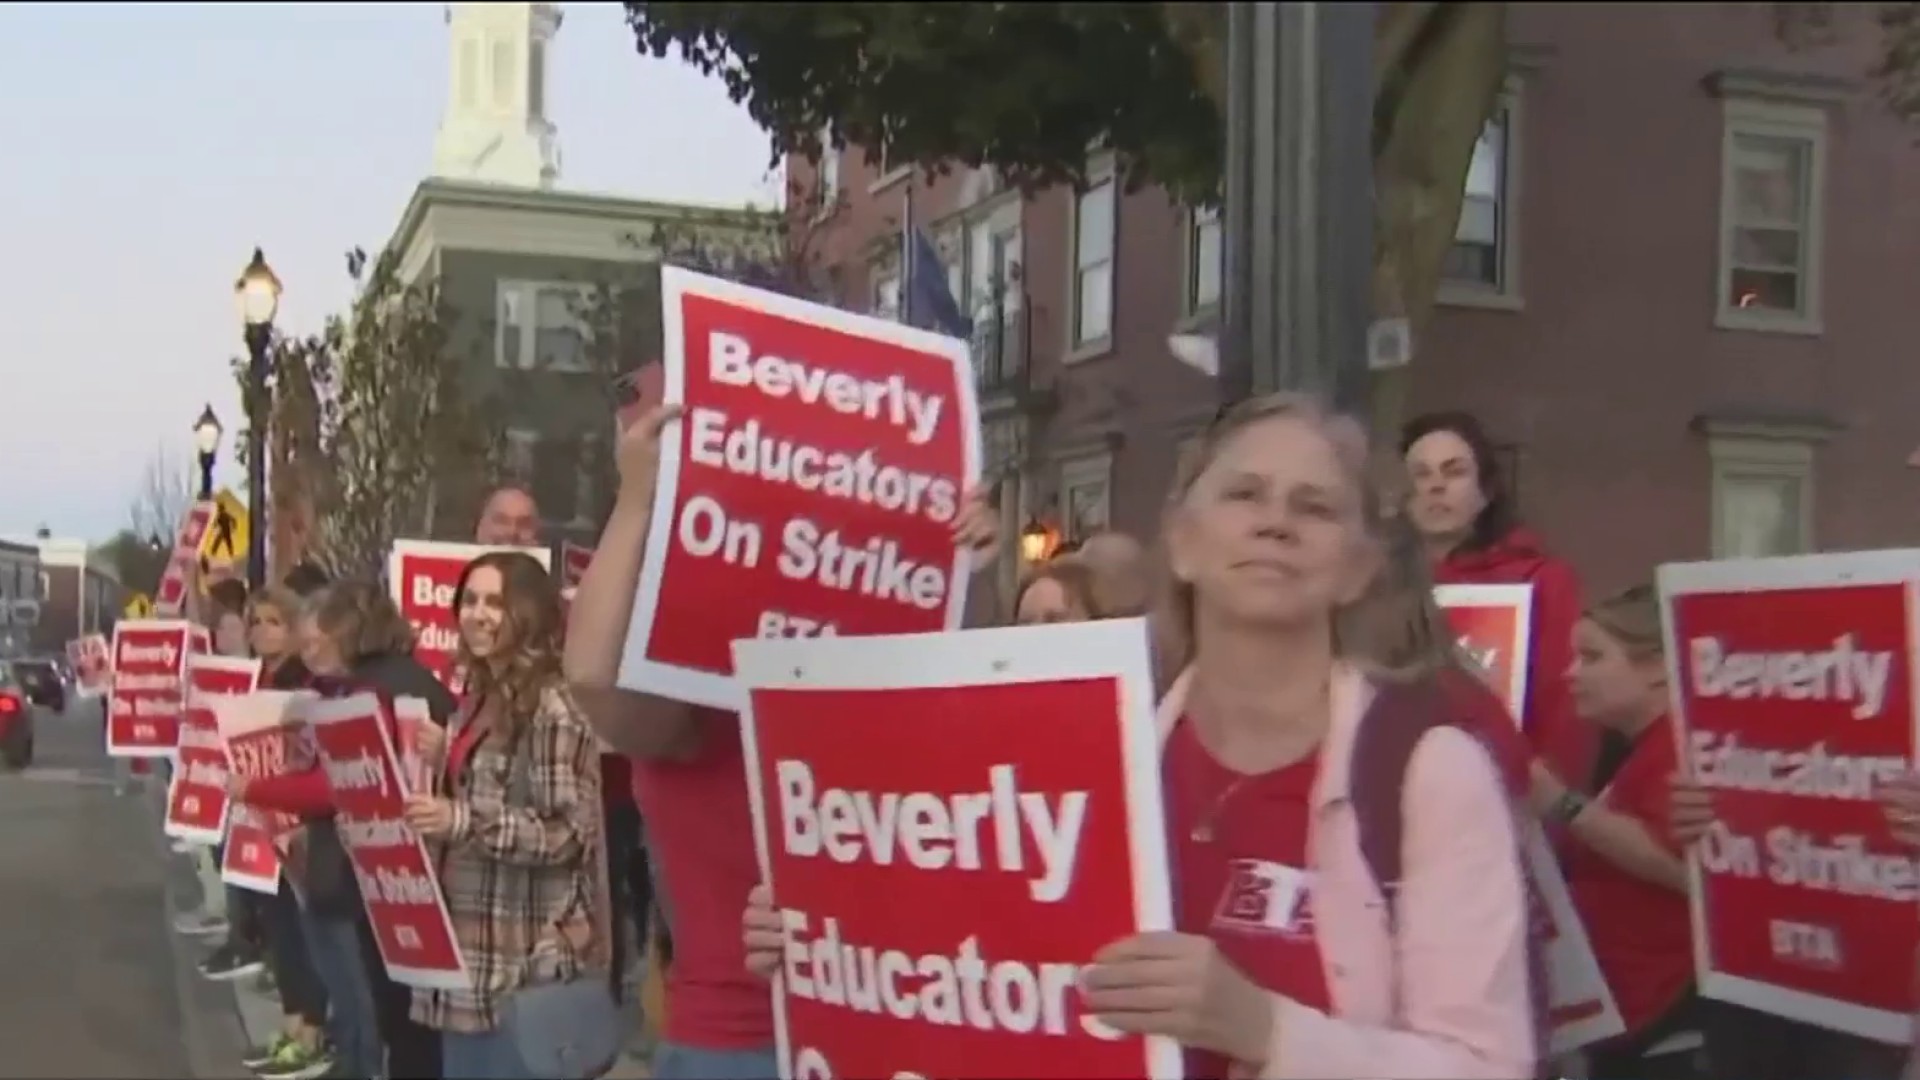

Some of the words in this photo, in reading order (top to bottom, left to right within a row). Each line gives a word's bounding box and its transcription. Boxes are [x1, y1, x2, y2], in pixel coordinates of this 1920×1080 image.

[709, 331, 945, 444] Beverly
[690, 407, 956, 523] Educators
[679, 495, 761, 569] On
[777, 519, 946, 610] Strike
[1690, 632, 1893, 721] Beverly
[776, 759, 1089, 902] Beverly
[1702, 819, 1760, 878] On
[781, 907, 1127, 1041] Educator
